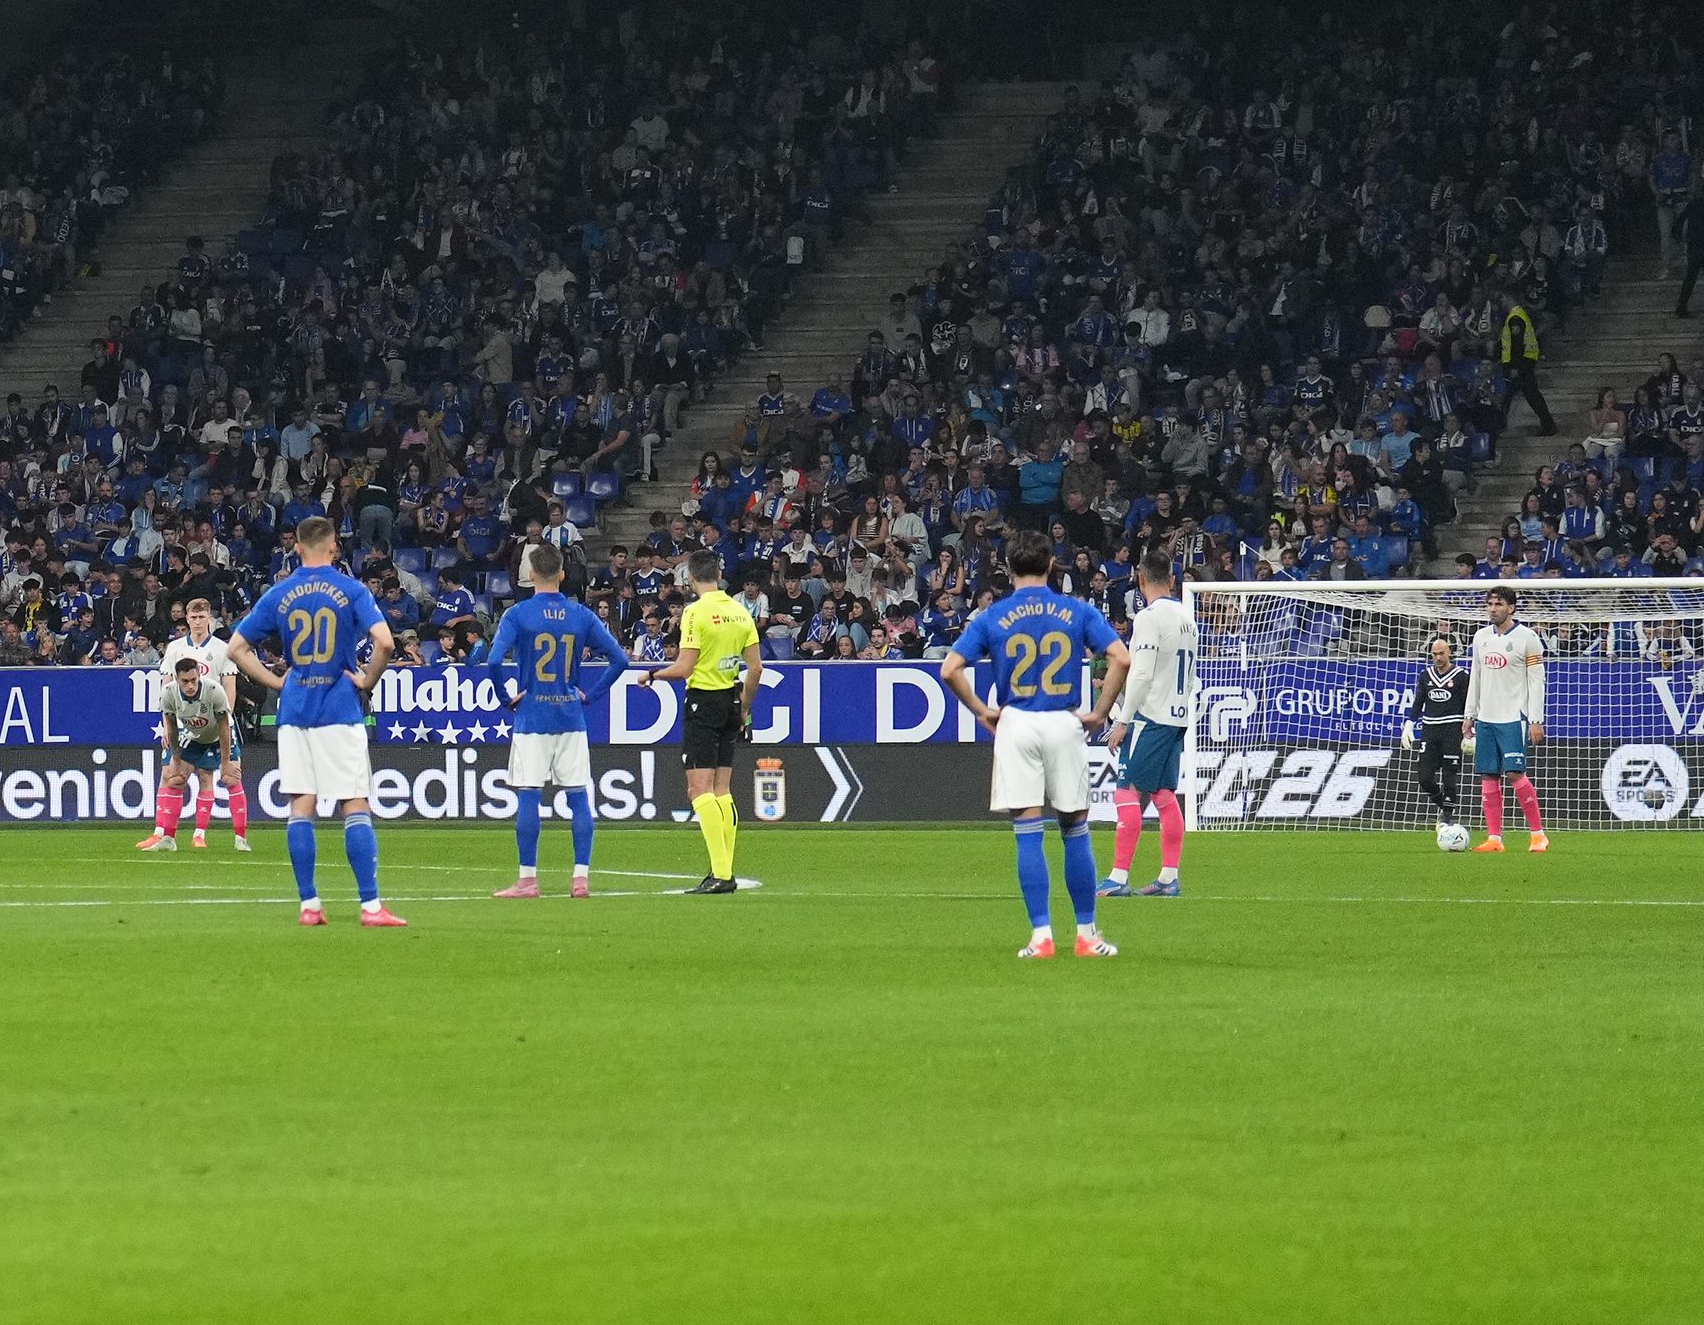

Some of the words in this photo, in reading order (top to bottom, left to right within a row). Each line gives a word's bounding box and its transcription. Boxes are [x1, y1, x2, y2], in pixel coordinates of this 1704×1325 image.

[277, 580, 350, 614] DENDONCKER
[543, 607, 567, 621] ILIĆ
[997, 603, 1044, 630] NACHO
[1046, 602, 1073, 625] V.M.
[288, 607, 337, 666] 20
[534, 632, 576, 684] 21
[1005, 631, 1072, 697] 22
[1483, 654, 1506, 669] DANI
[1275, 687, 1375, 716] GRUPO
[1617, 759, 1673, 787] EA
